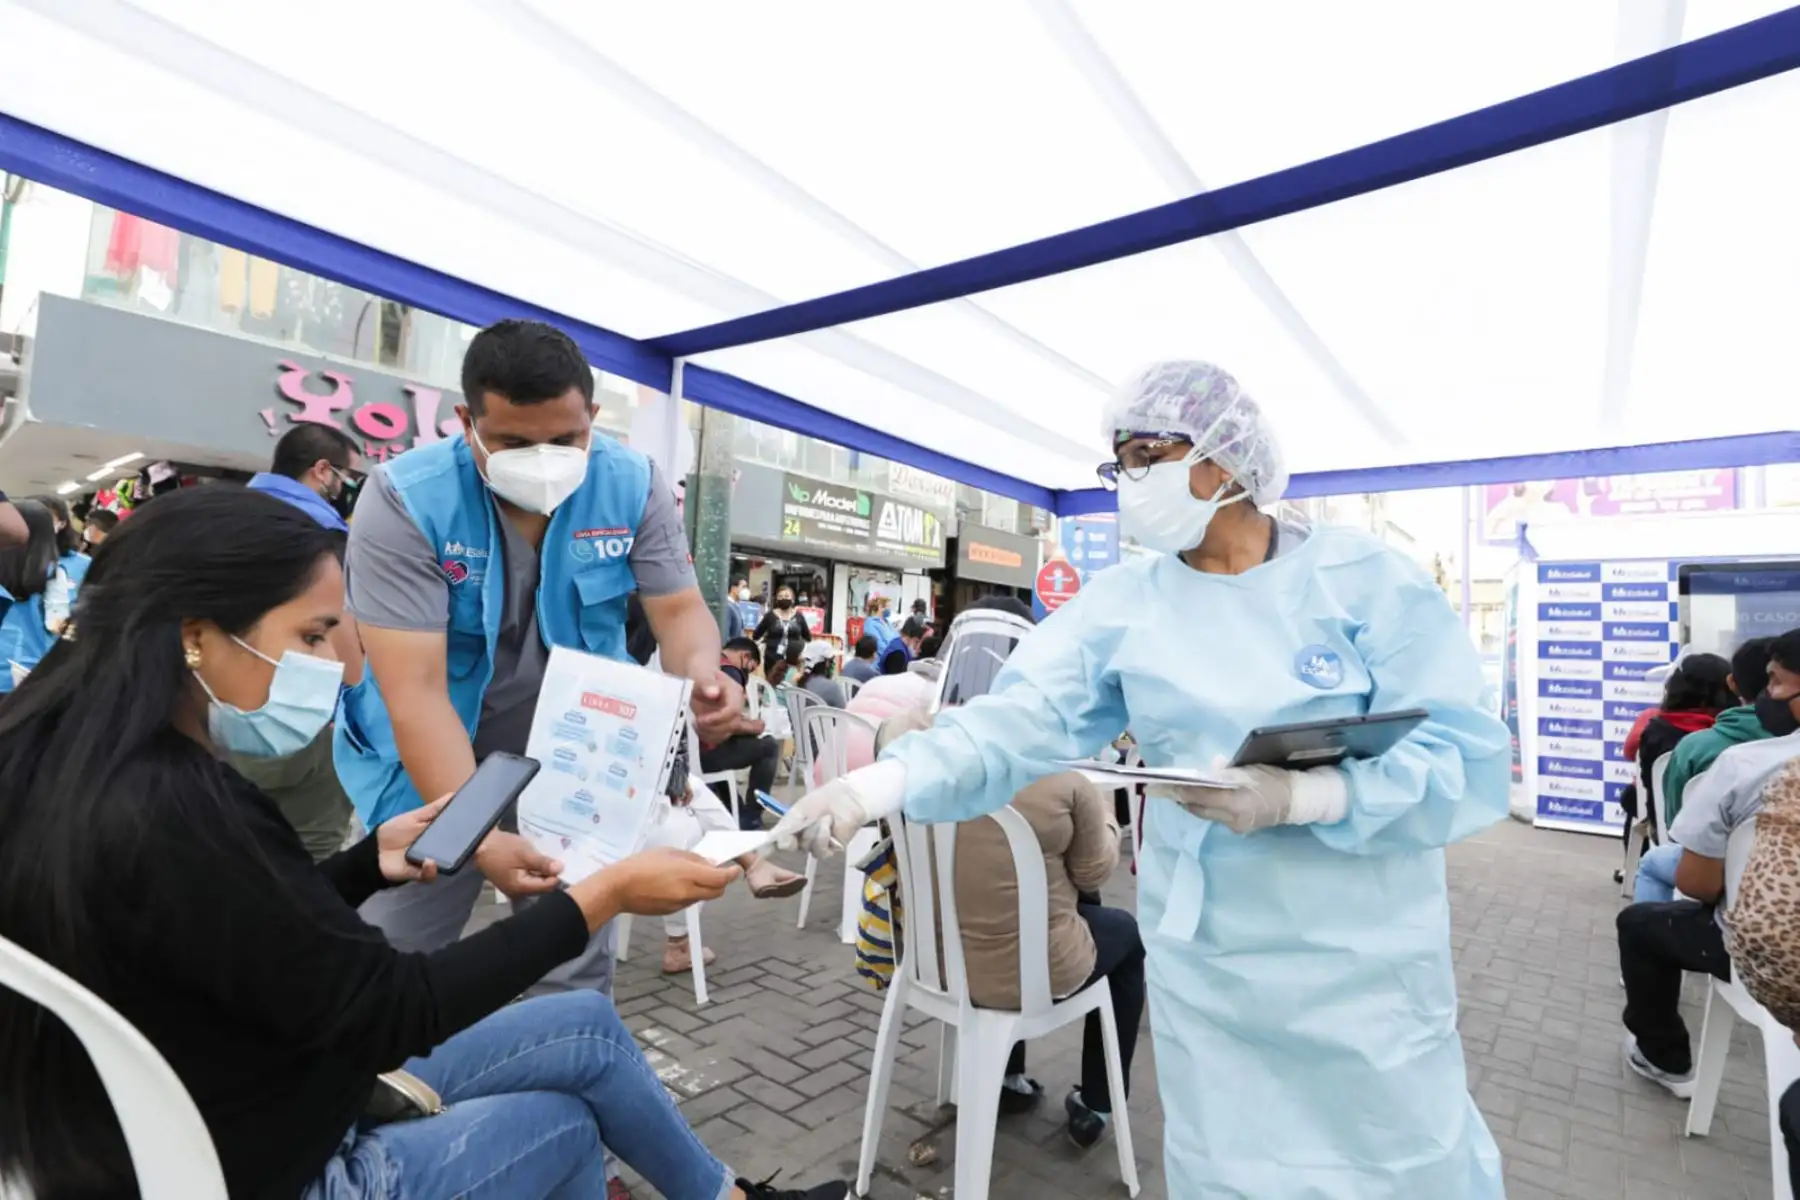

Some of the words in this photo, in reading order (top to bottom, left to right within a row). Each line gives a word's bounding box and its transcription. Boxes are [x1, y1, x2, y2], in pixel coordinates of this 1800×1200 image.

[278, 358, 465, 447] Yol
[812, 489, 857, 513] Model
[783, 518, 800, 536] 24
[594, 537, 635, 559] 107
[1753, 611, 1800, 624] CASO
